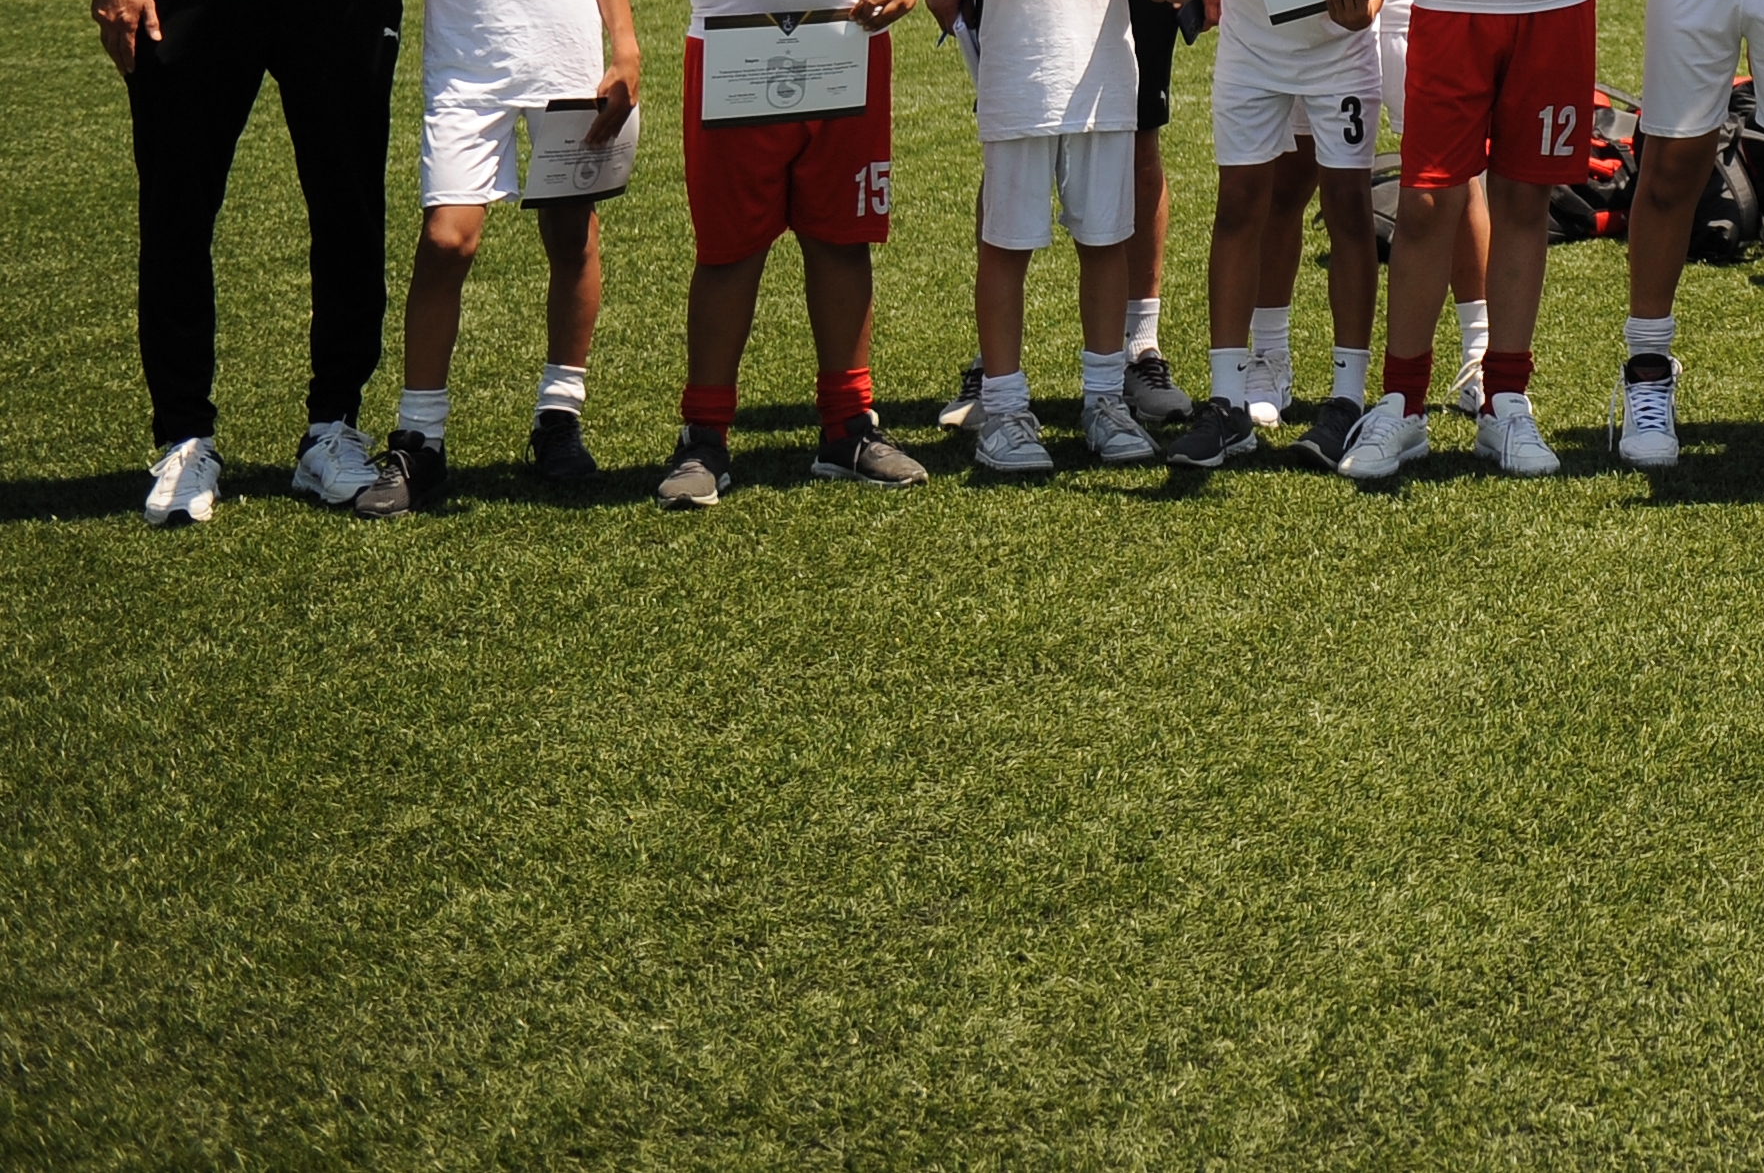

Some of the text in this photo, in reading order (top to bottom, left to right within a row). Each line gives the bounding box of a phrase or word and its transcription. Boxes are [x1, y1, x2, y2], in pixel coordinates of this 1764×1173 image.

[1341, 96, 1364, 144] 3
[1539, 105, 1576, 157] 12
[855, 161, 891, 217] 15
